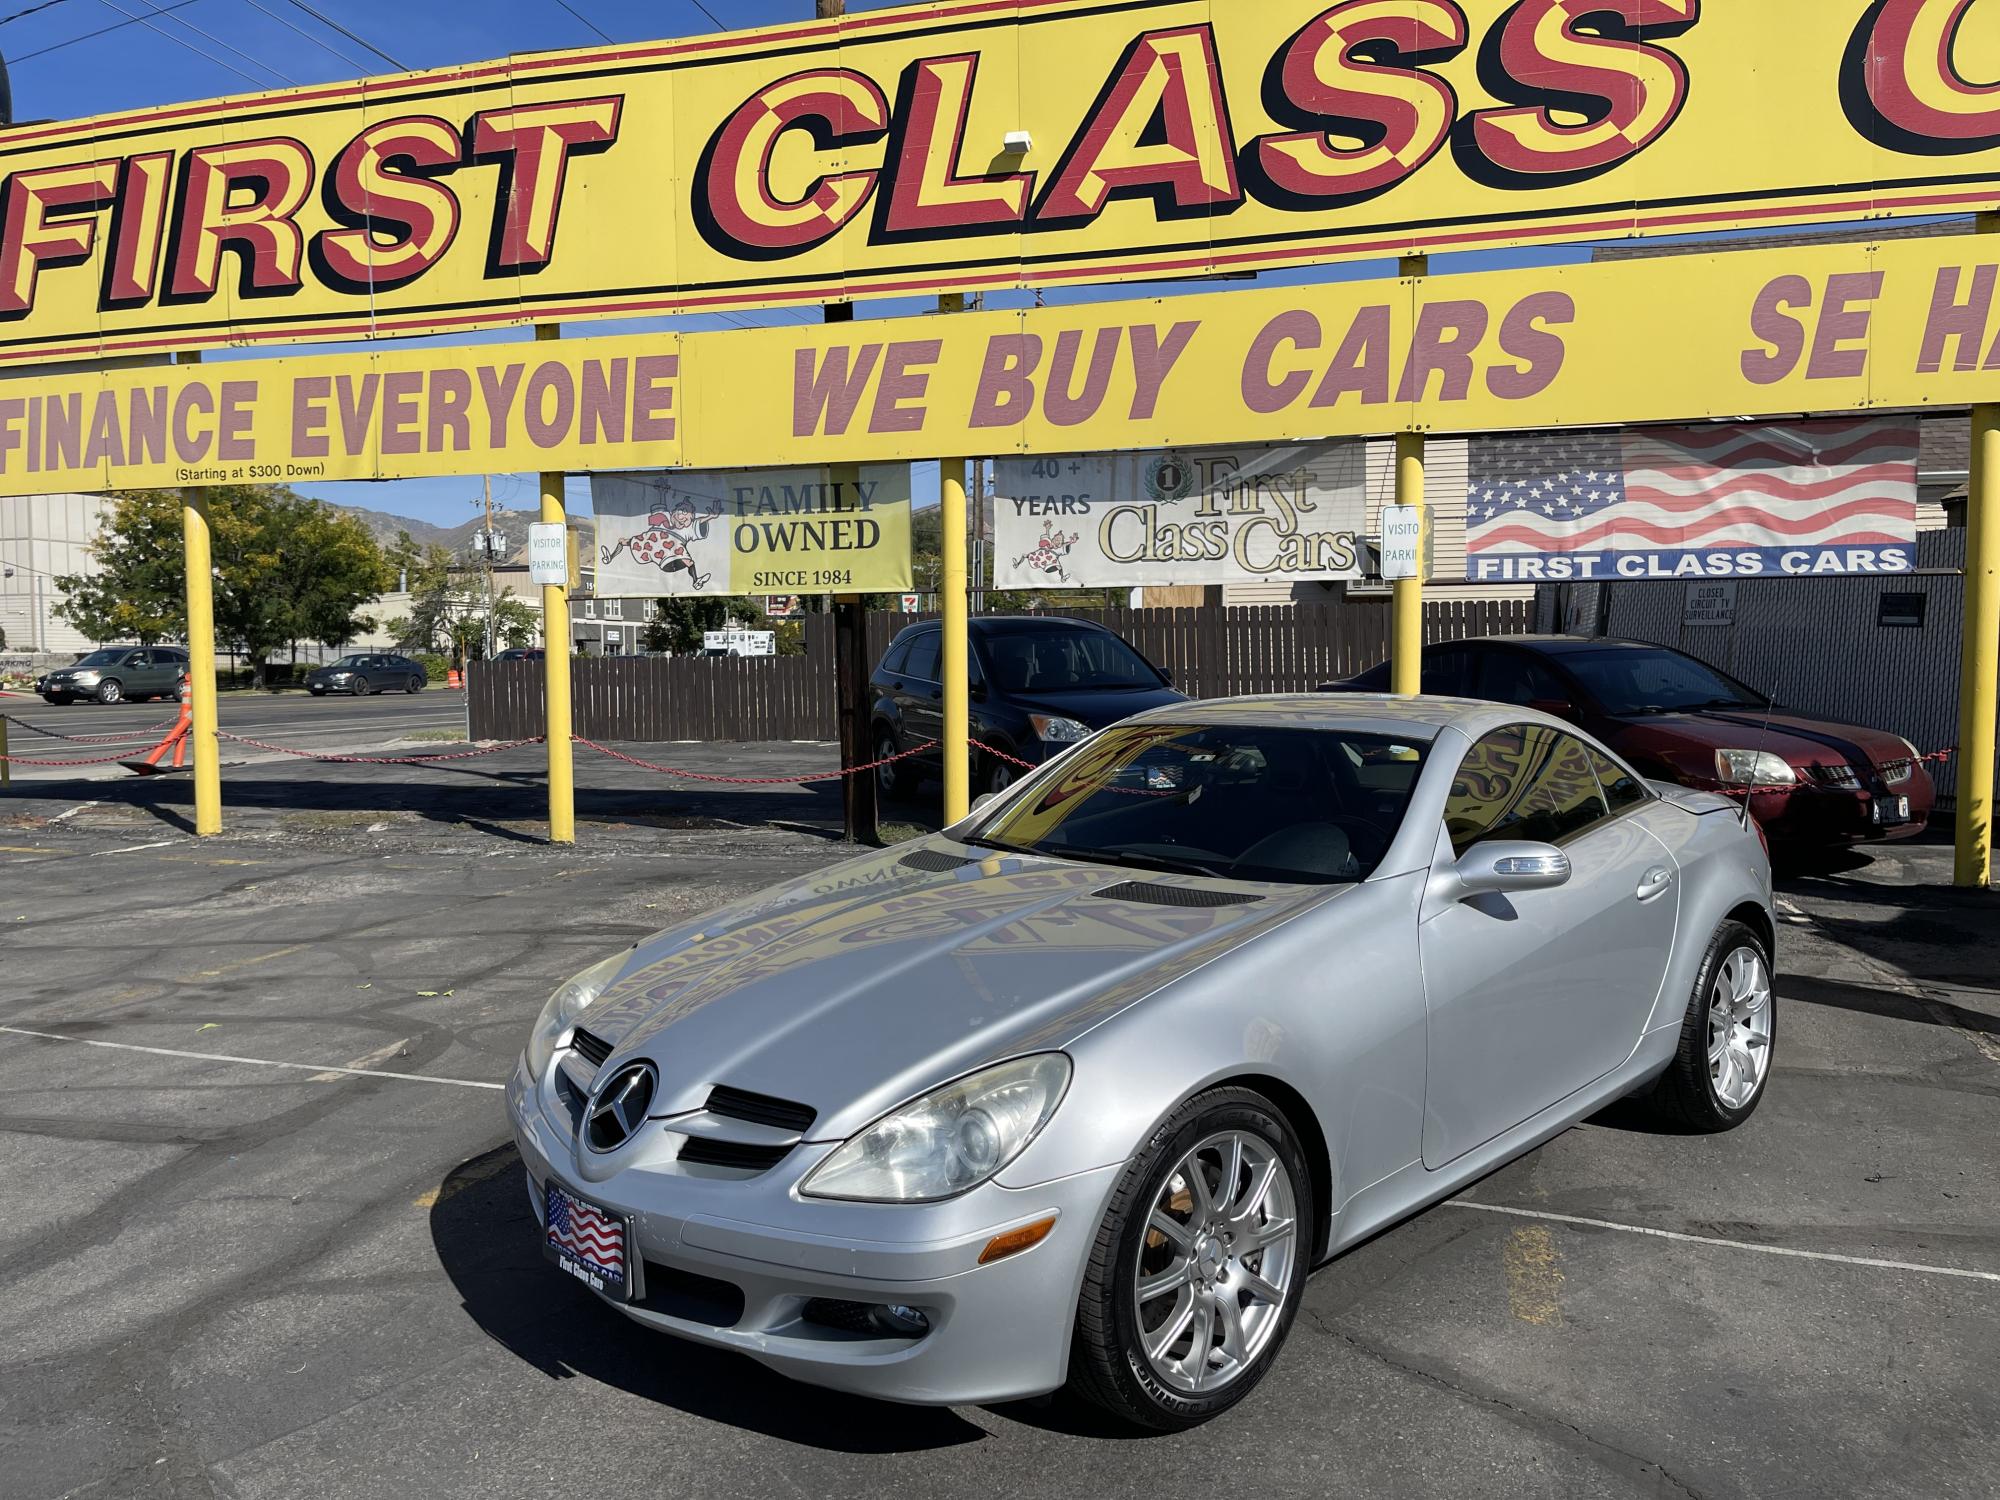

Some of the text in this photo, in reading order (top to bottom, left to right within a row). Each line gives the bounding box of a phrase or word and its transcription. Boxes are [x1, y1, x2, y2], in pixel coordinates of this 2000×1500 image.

[0, 94, 625, 320] FIRST
[691, 0, 1699, 262] CLASS
[0, 381, 258, 474] FINANCE
[291, 354, 679, 458] EVERYONE
[793, 338, 943, 438] WE
[968, 320, 1201, 428] BUY
[1241, 291, 1575, 414] CARS
[1740, 270, 1885, 385] SE
[175, 462, 325, 481] (Starting at $300 Down)
[1031, 457, 1060, 479] 40
[733, 481, 879, 517] FAMILY
[1194, 455, 1318, 534] First
[1011, 494, 1091, 517] YEARS
[734, 518, 881, 554] OWNED
[1097, 503, 1357, 575] Class Cars
[1388, 523, 1419, 535] VISITO
[533, 538, 561, 548] VISITOR
[531, 560, 564, 570] PARKING
[1385, 549, 1417, 561] PARKI
[1477, 548, 1909, 579] FIRST CLASS CARS
[753, 568, 852, 586] SINCE 1984
[1698, 588, 1724, 598] CLOSED
[1691, 598, 1730, 609] CIRCUIT TV
[1685, 609, 1734, 620] SURVEILLANCE
